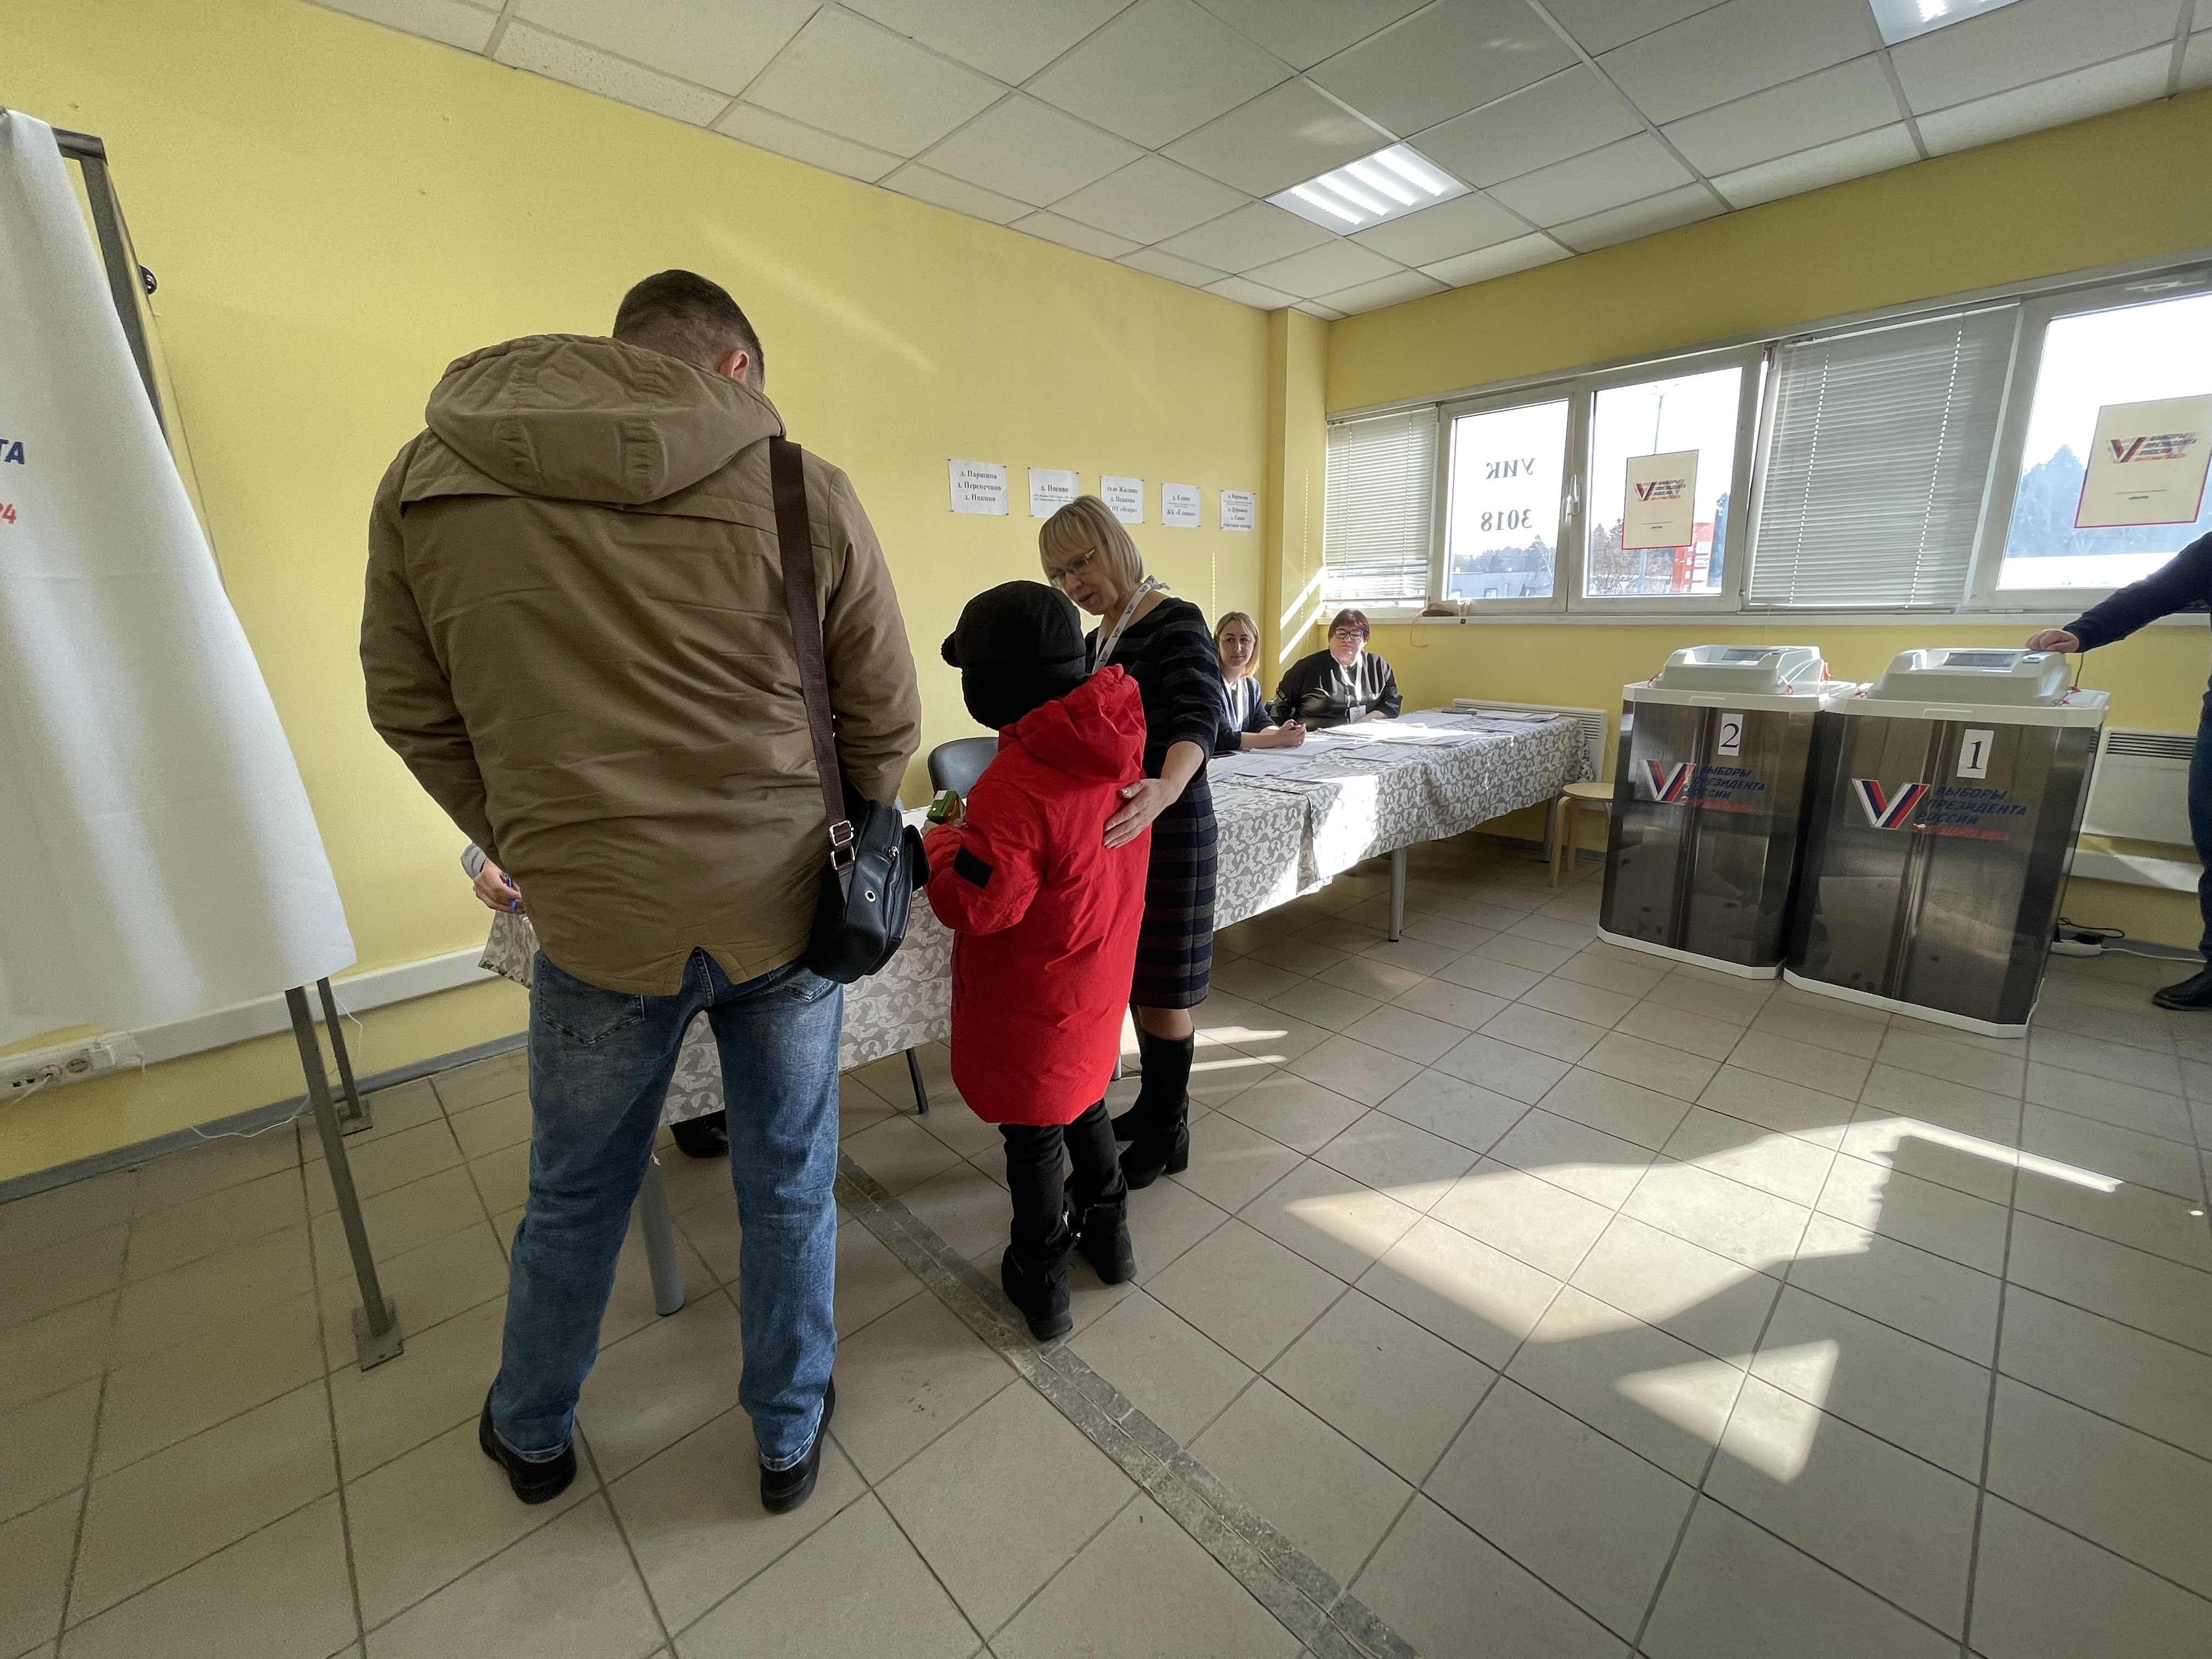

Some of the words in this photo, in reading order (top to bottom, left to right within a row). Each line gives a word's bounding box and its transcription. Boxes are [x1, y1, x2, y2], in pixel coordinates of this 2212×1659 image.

[967, 470, 997, 479] Паршино
[964, 481, 1001, 491] Перепечино
[1048, 484, 1069, 493] Носово
[1720, 723, 1739, 748] 2
[1966, 741, 1982, 770] 1
[1936, 786, 2007, 800] ВЫБОРЫ
[1927, 799, 2027, 816] ПРЕЗИДЕНТА
